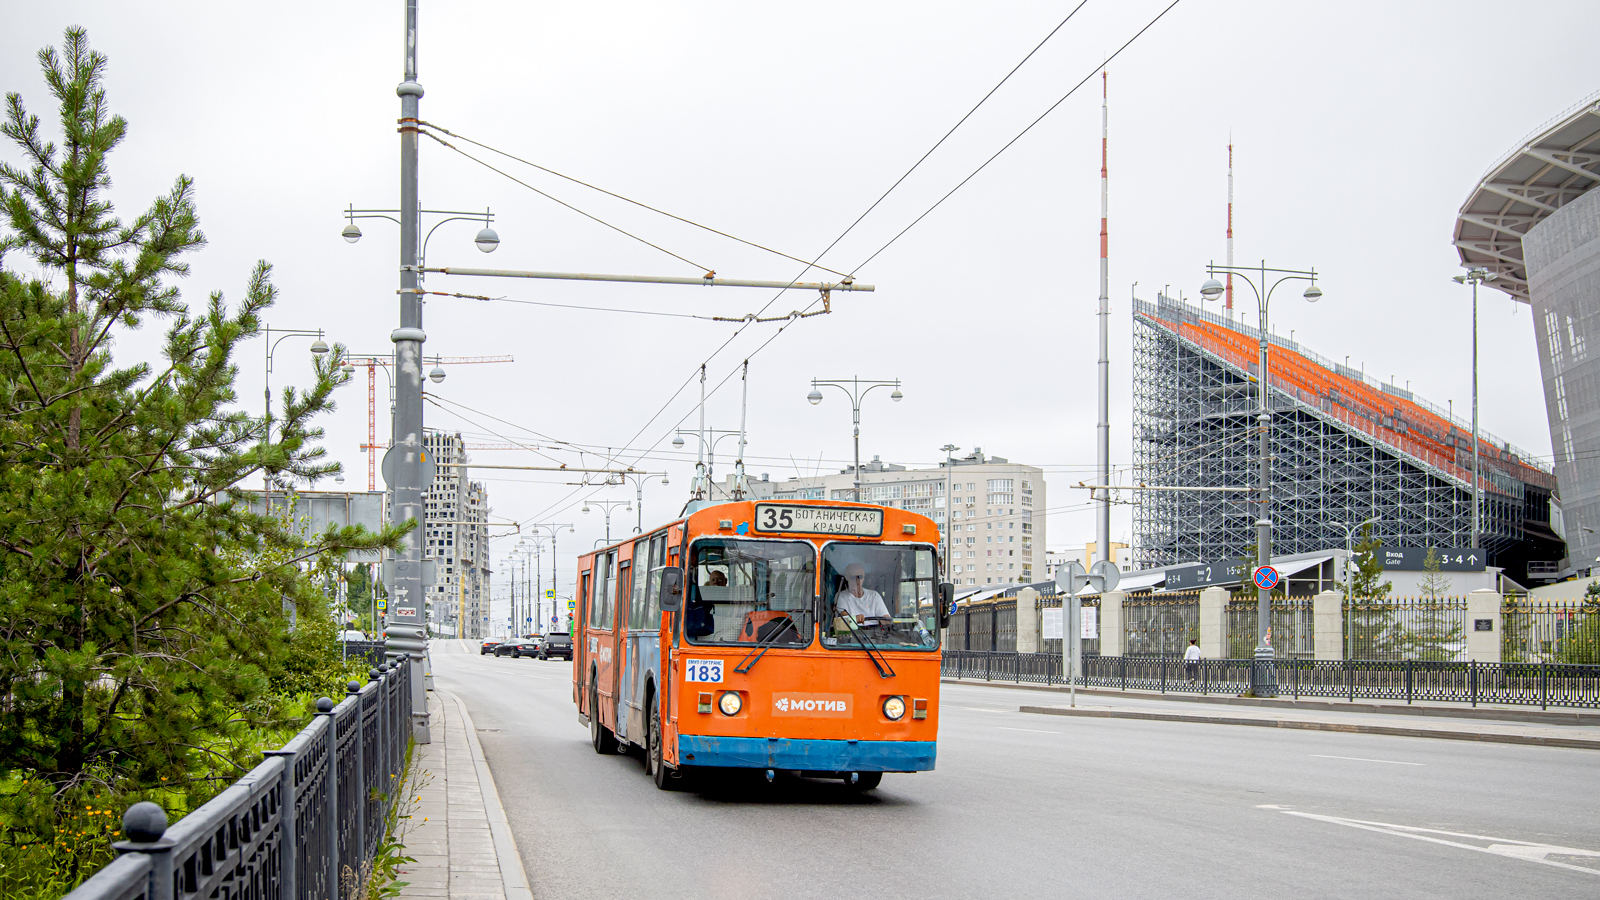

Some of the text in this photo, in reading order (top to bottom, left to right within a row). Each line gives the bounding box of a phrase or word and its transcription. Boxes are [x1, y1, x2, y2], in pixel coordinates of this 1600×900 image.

[763, 508, 793, 529] 35
[795, 509, 876, 522] БОТАНИЧЕСКАЯ
[813, 522, 857, 533] КРАУЛЯ
[1205, 566, 1212, 582] 2
[688, 665, 721, 682] 183
[790, 699, 847, 711] МОТИВ
